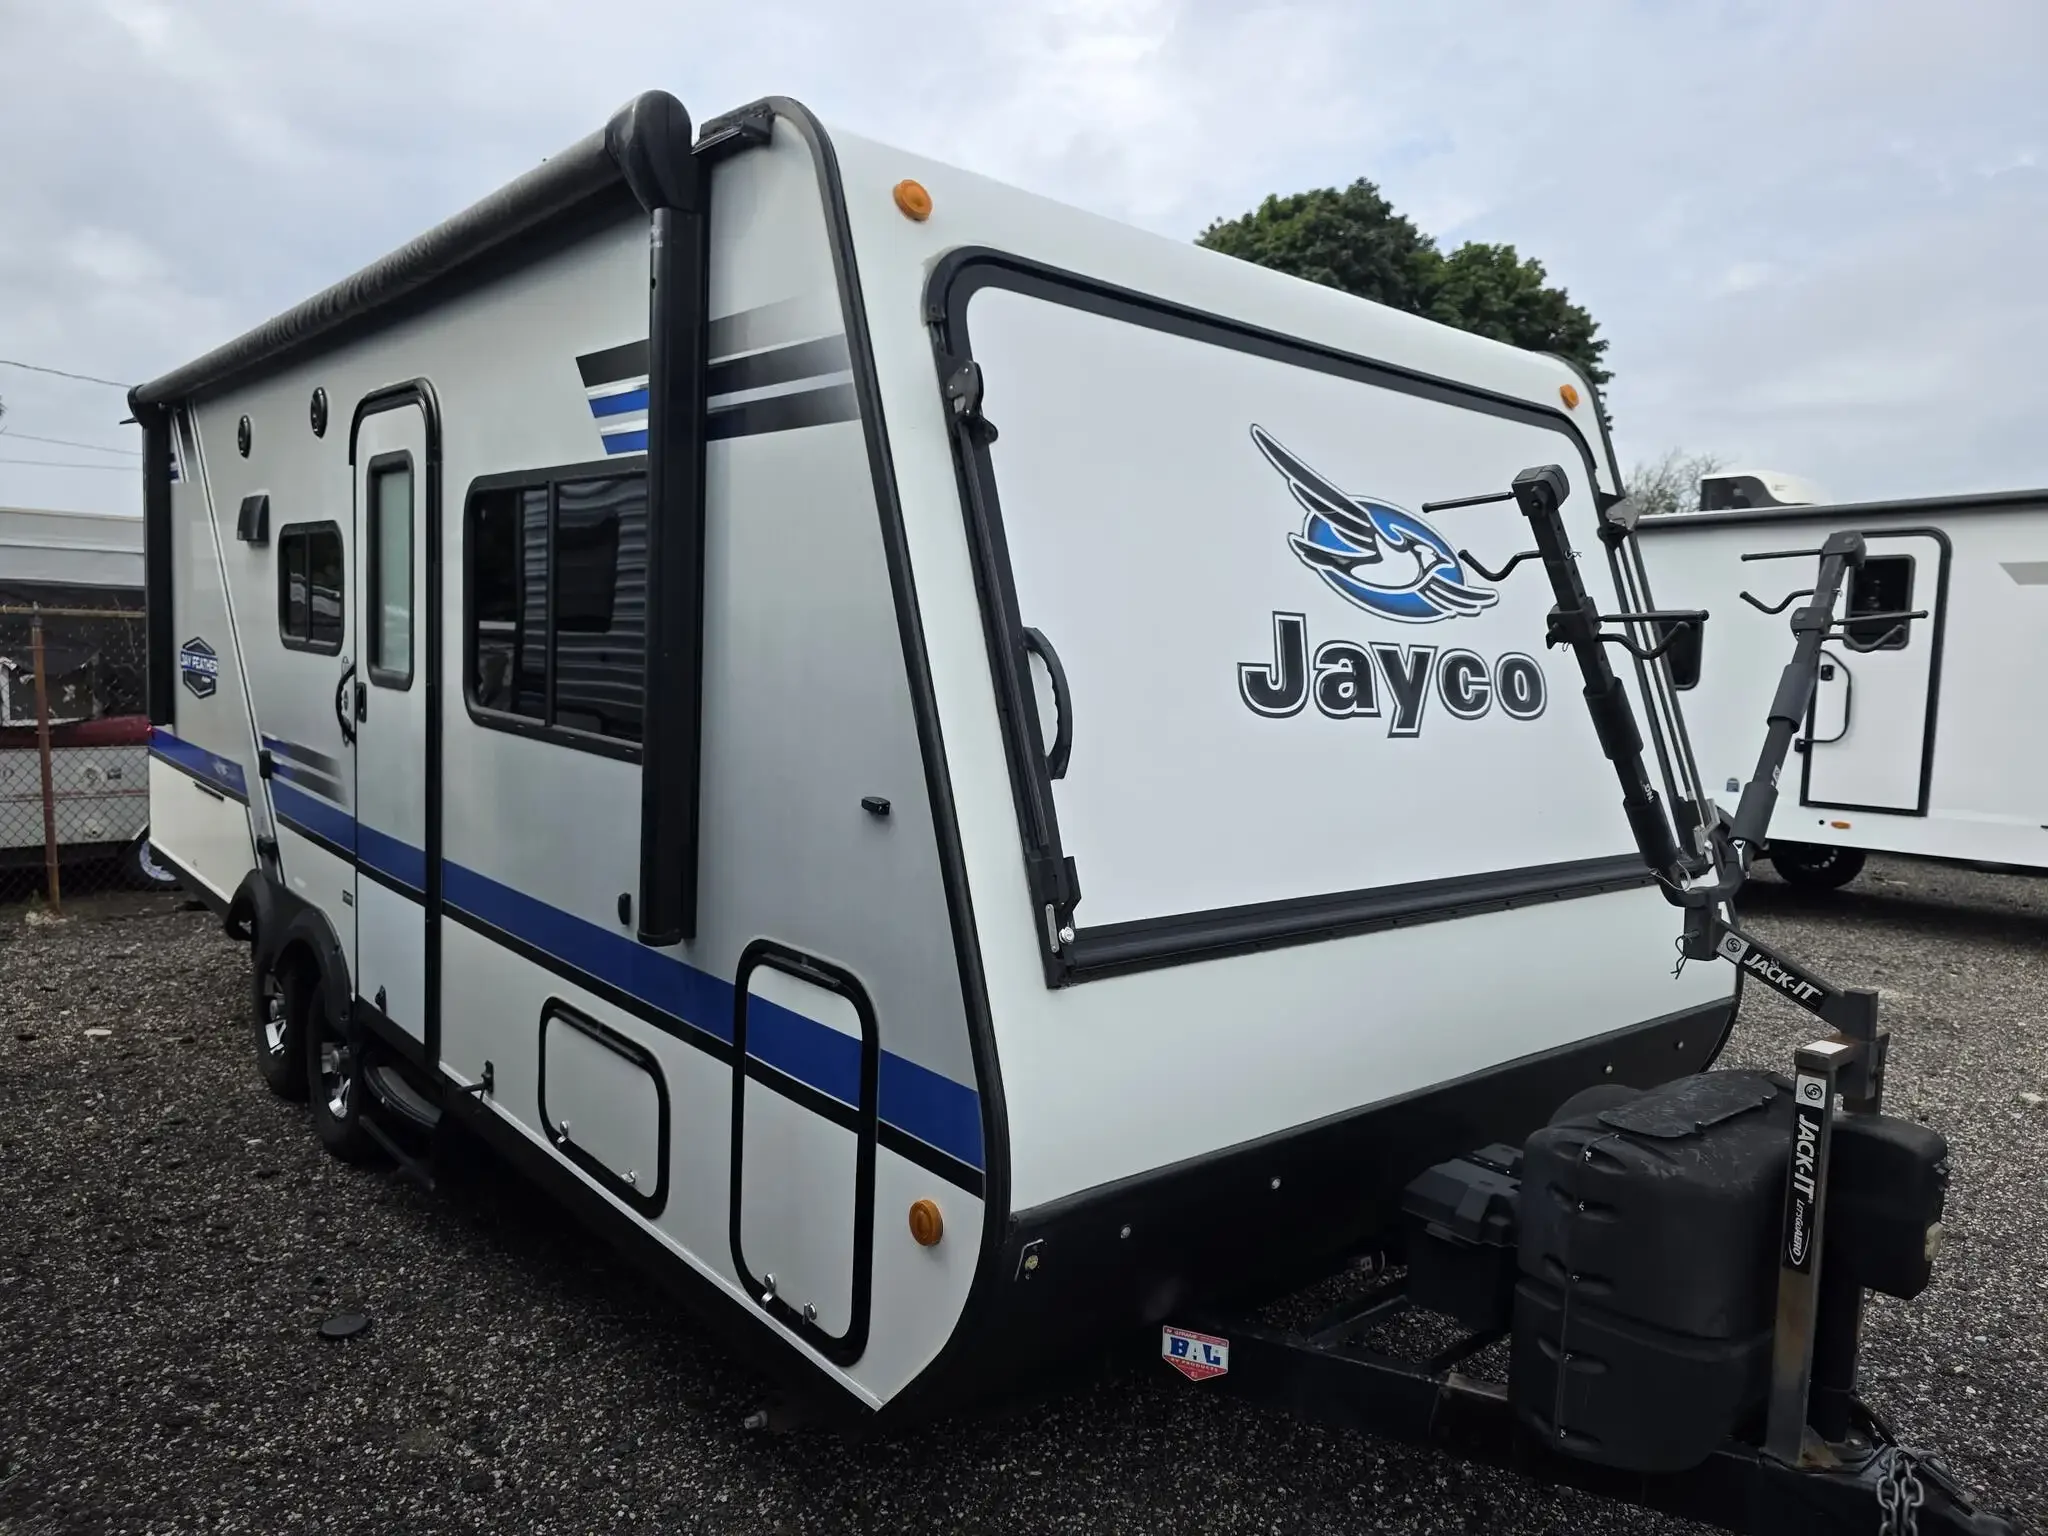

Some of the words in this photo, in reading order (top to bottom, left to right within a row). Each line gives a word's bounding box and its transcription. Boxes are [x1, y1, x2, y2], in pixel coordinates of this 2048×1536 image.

[1237, 611, 1547, 738] Jayco
[1744, 954, 1822, 1000] JACK-IT
[1794, 1114, 1819, 1203] JACK-IT
[1170, 1337, 1221, 1366] BAL
